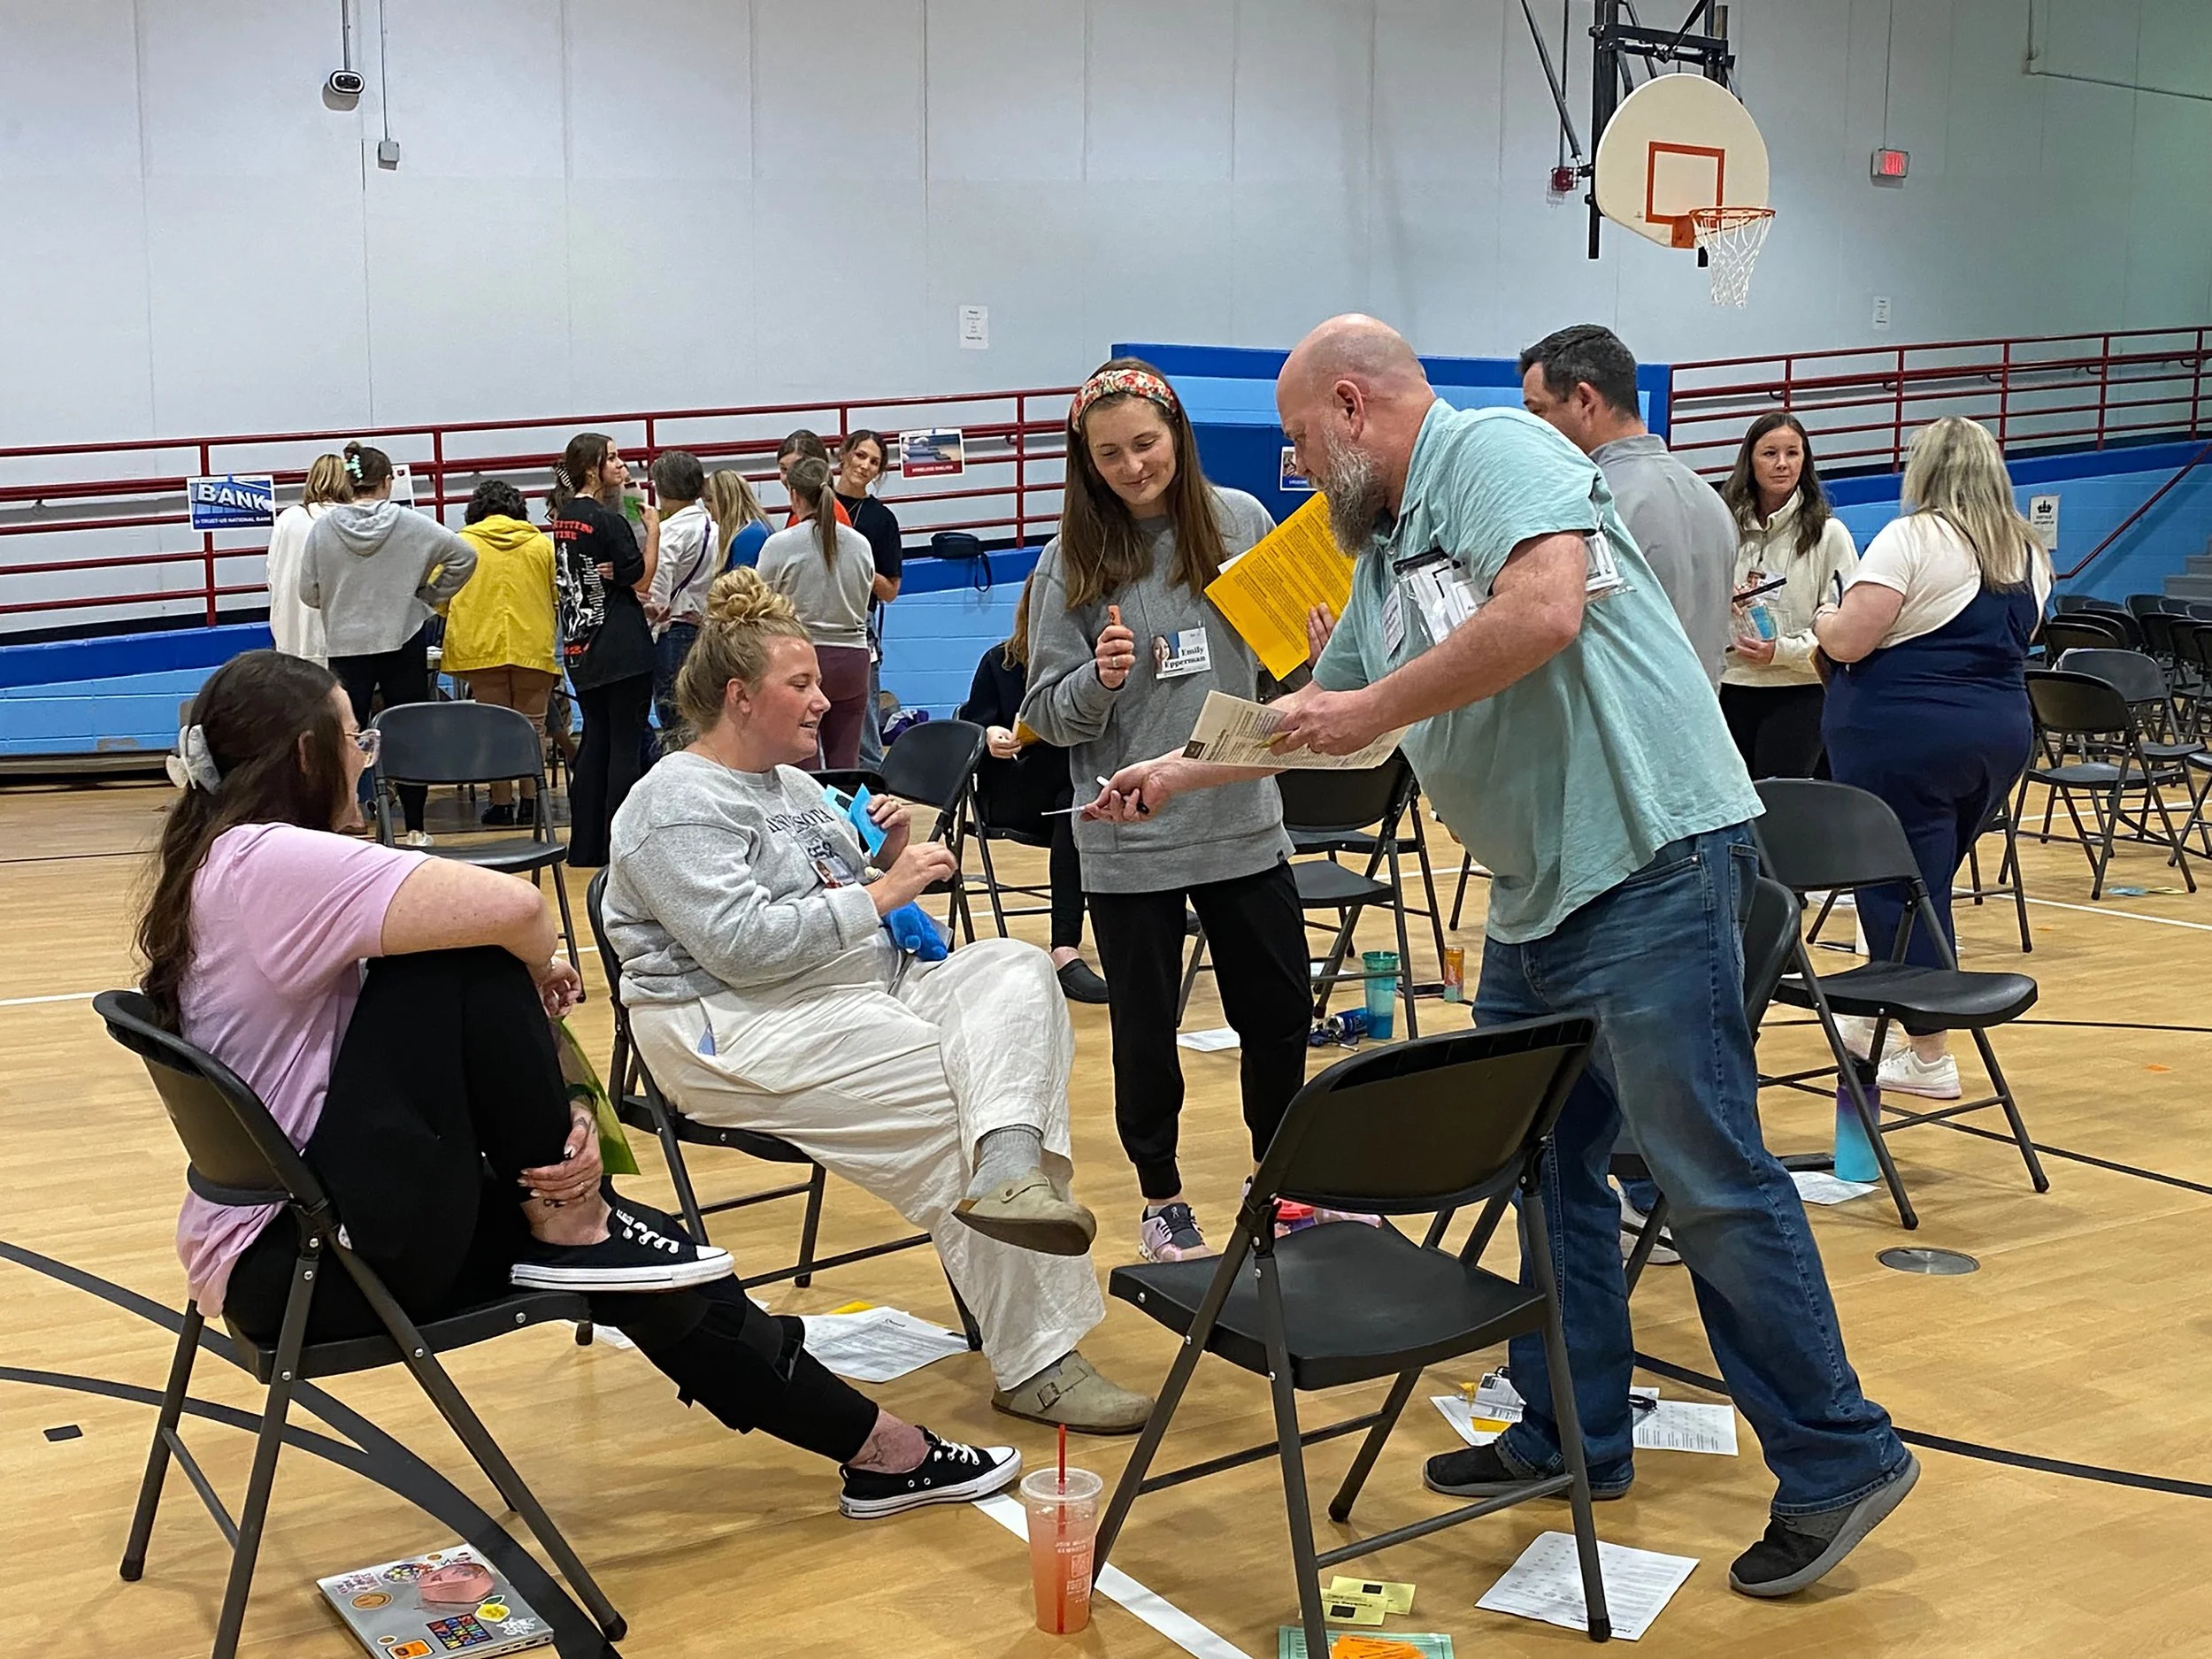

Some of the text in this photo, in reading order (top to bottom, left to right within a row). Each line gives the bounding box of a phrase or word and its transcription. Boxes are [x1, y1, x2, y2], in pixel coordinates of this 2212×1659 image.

[197, 483, 265, 511] BANK
[1181, 646, 1203, 657] Emily
[1164, 656, 1206, 668] Epperman
